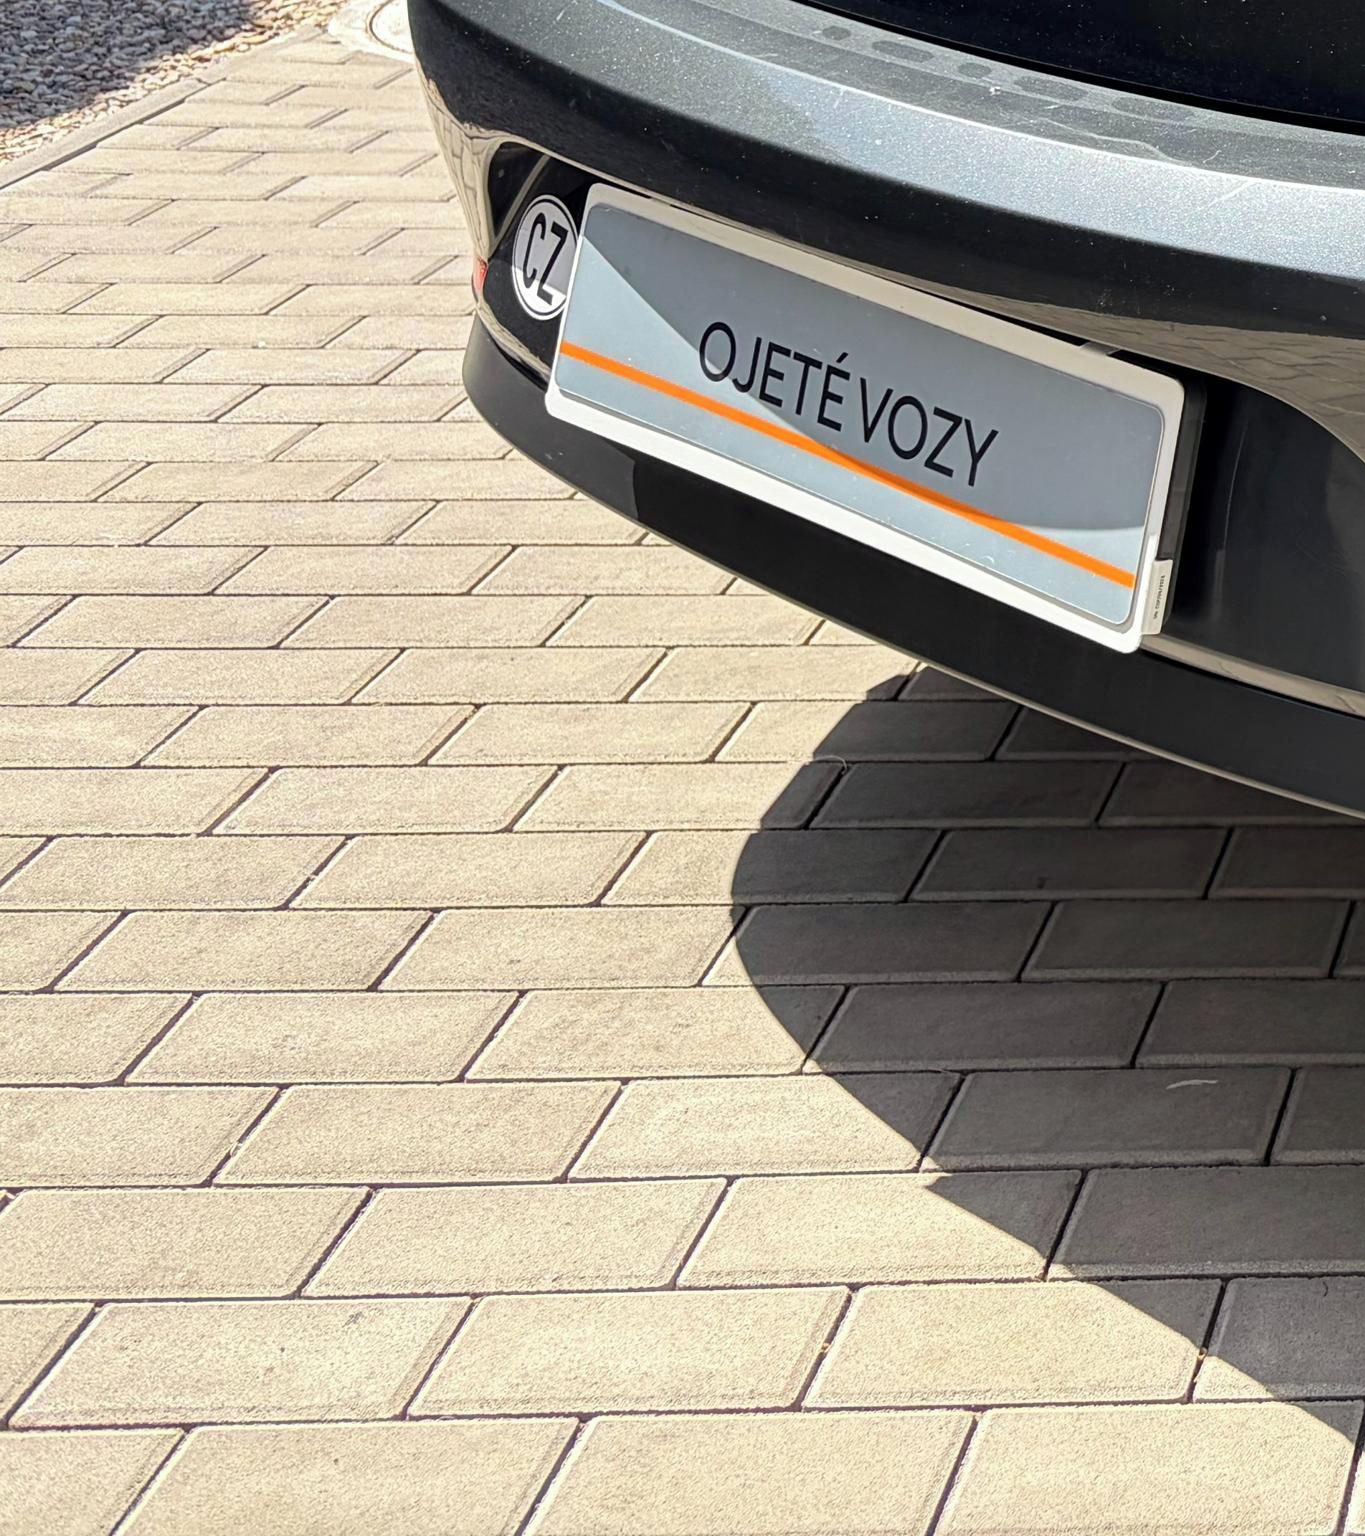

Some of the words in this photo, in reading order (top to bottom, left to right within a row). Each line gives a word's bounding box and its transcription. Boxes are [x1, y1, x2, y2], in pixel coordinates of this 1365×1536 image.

[522, 211, 569, 306] CZ
[698, 320, 852, 433] OJETÉ
[859, 376, 1000, 488] VOZY
